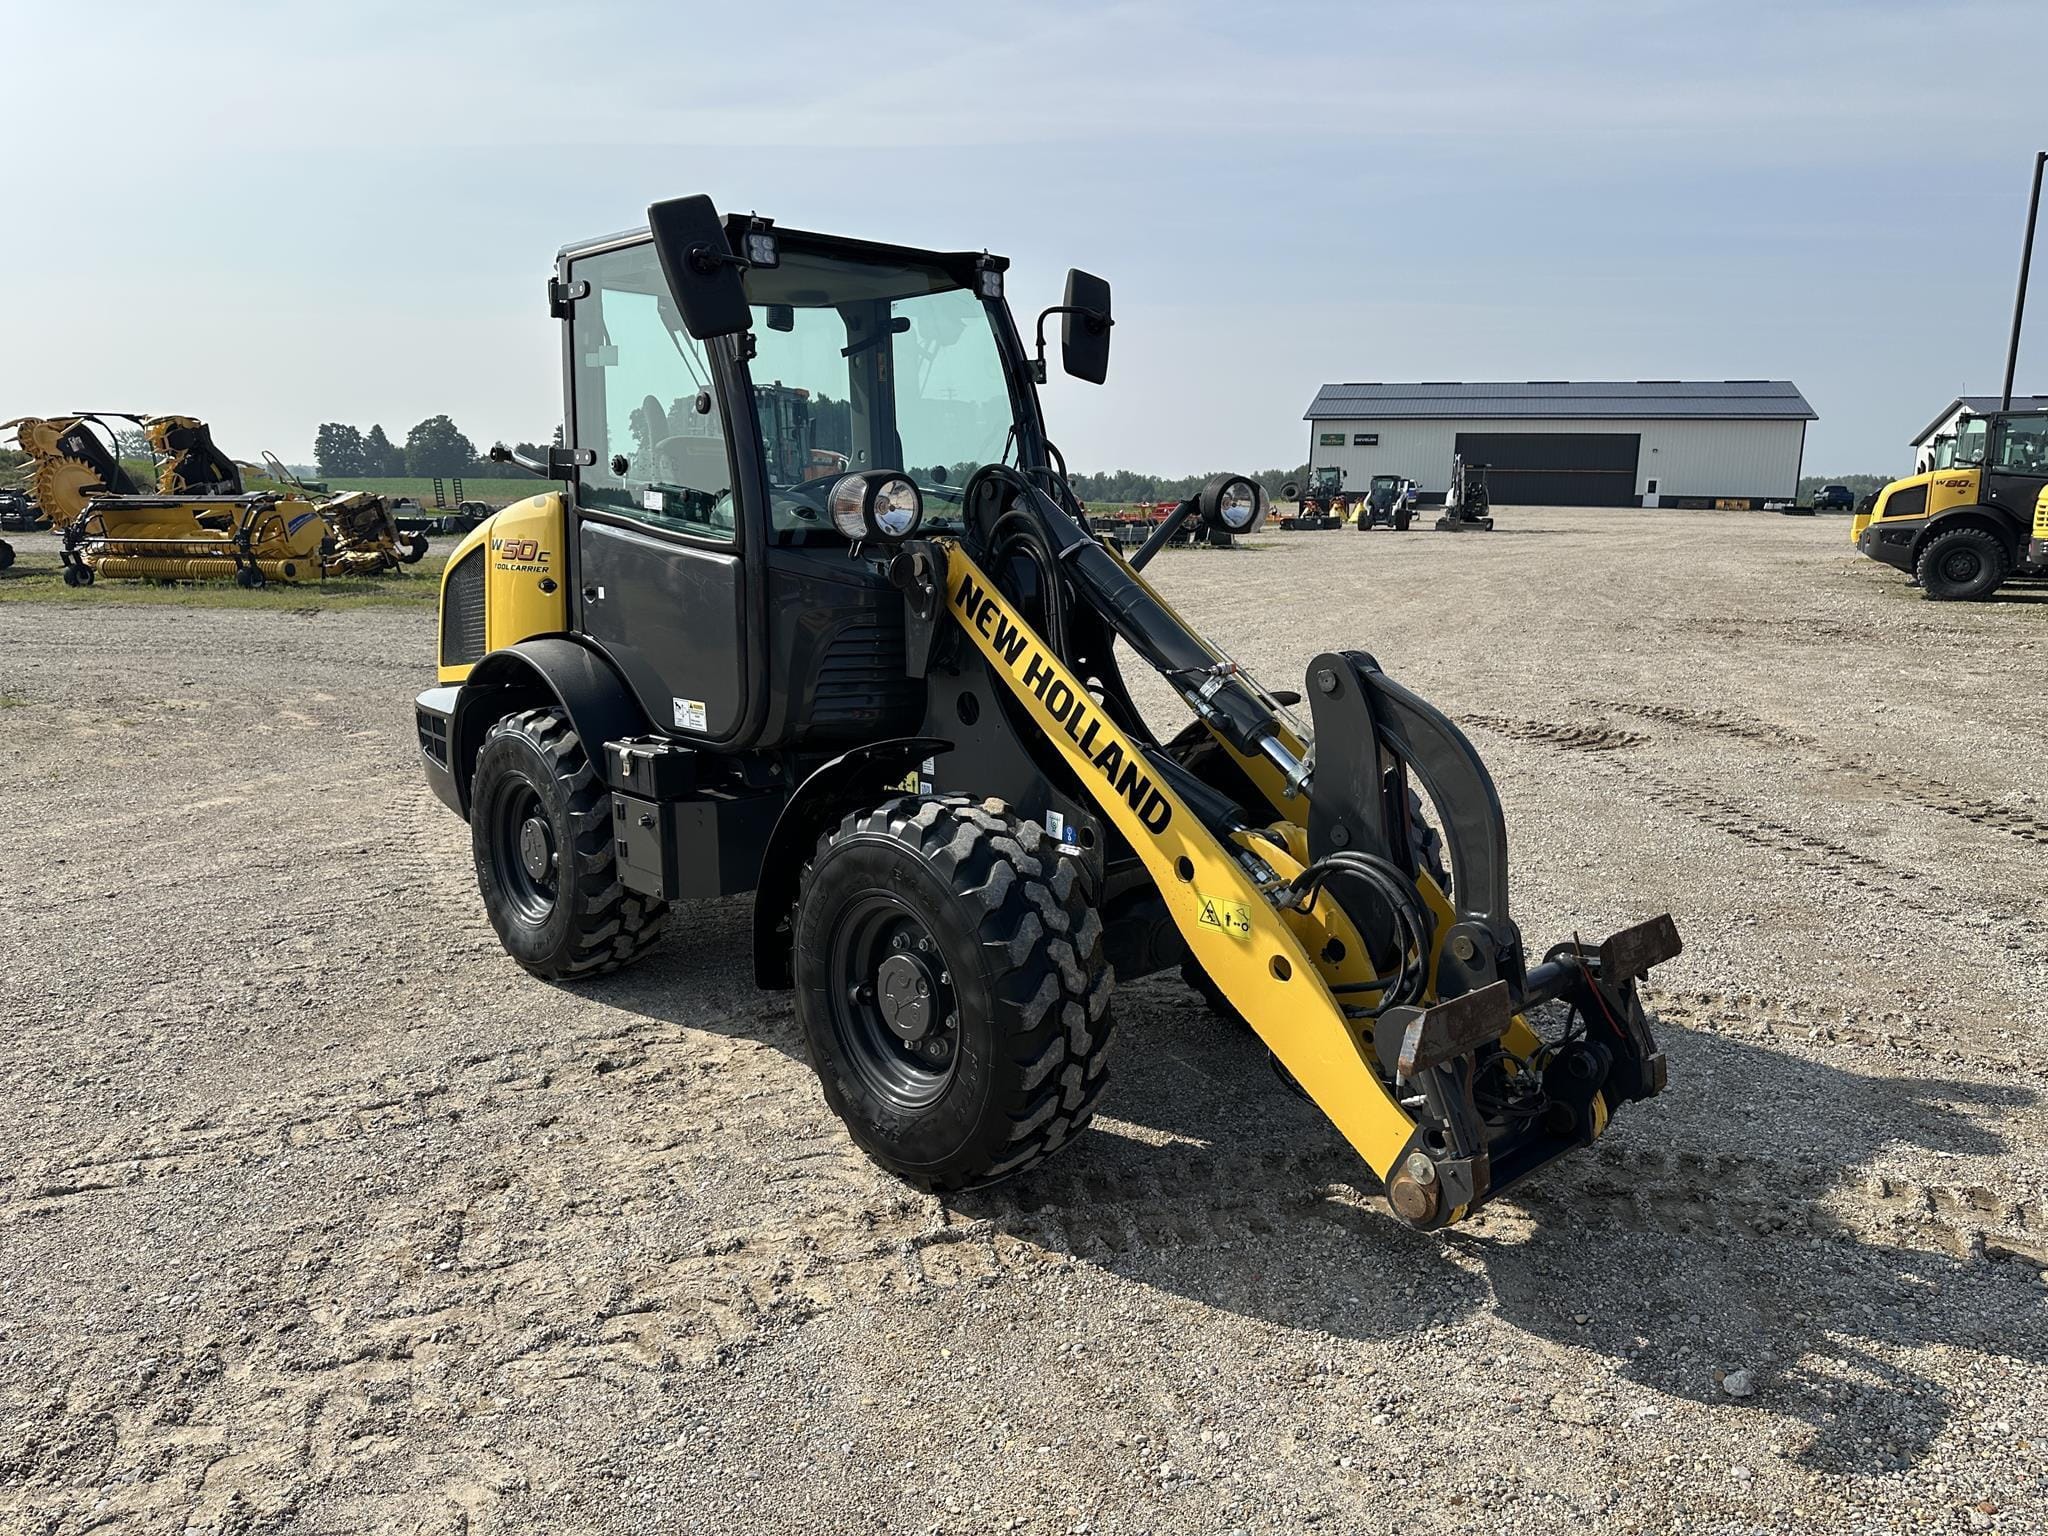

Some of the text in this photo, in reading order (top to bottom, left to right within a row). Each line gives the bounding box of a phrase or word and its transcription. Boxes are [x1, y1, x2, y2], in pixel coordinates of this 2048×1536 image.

[510, 565, 549, 573] CARRIER
[954, 573, 1172, 835] NEW HOLLAND
